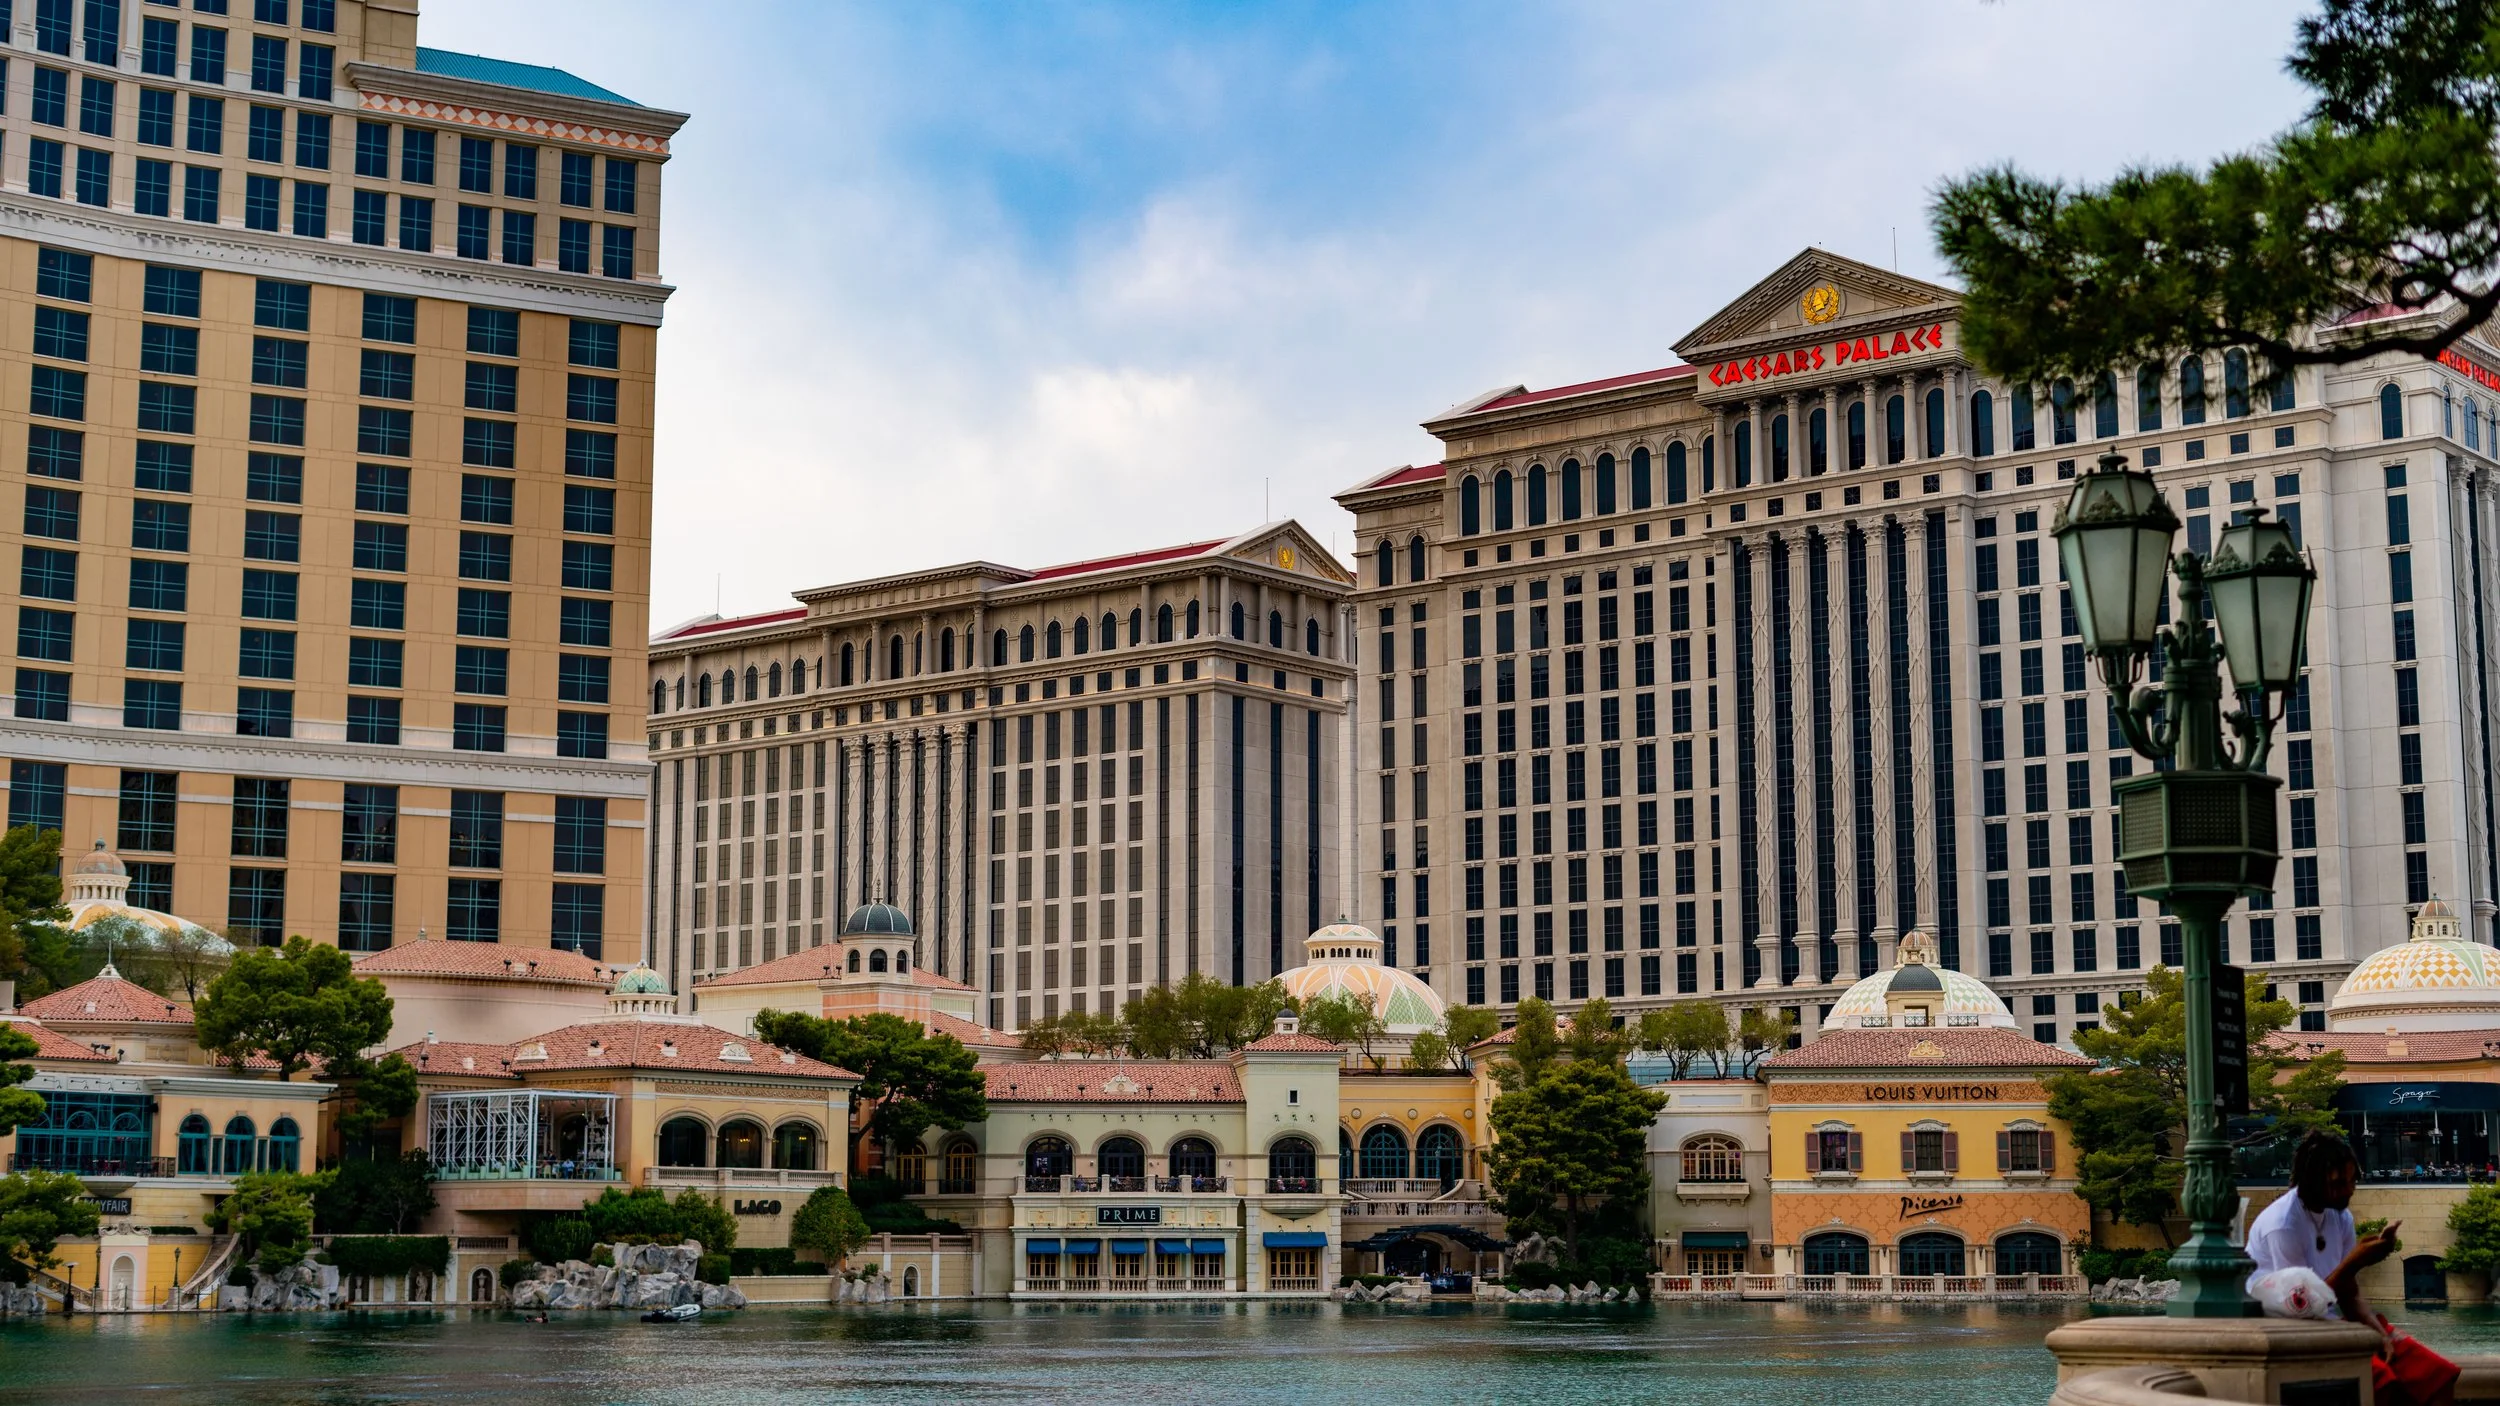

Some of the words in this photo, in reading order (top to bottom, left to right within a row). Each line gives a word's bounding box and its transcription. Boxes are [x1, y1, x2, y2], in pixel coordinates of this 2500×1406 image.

[1708, 346, 1825, 387] CAESARS
[1836, 323, 1943, 366] PALACE
[2437, 348, 2472, 378] AESARS
[1866, 1087, 1915, 1100] LOUIS
[1922, 1086, 1997, 1100] VUITTON
[2389, 1087, 2440, 1105] Spago
[734, 1199, 782, 1215] LAGO
